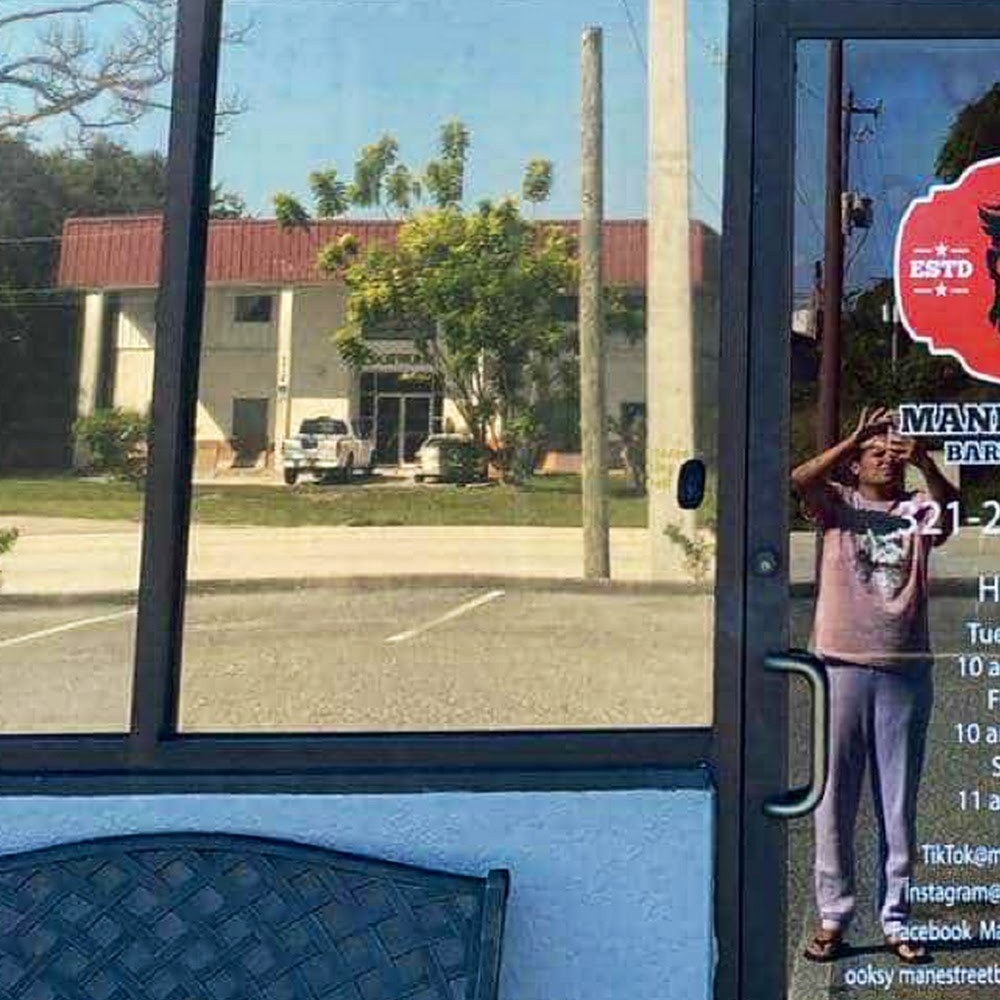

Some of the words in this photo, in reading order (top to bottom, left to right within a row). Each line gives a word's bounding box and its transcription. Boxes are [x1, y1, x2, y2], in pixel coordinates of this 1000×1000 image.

[909, 260, 973, 279] ESTD
[957, 657, 983, 677] 10
[957, 724, 979, 743] 10
[958, 791, 983, 810] 11
